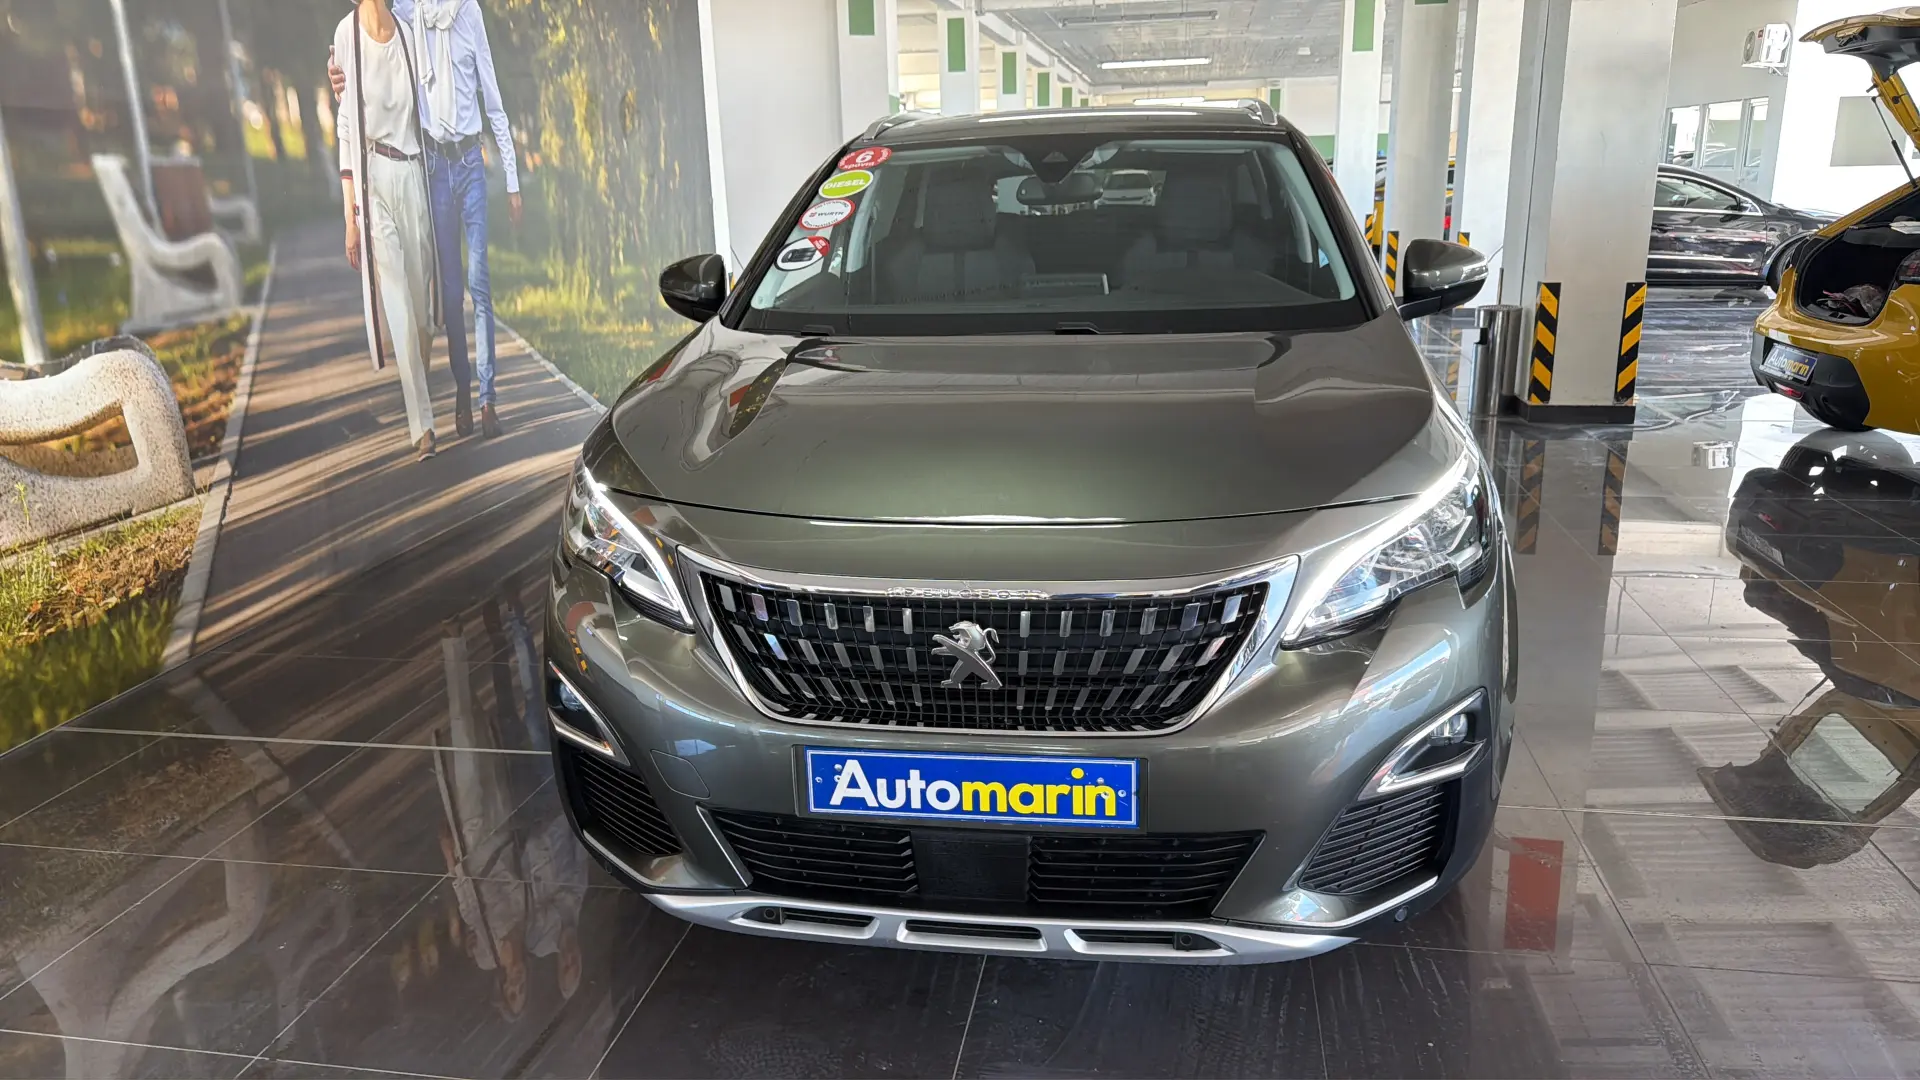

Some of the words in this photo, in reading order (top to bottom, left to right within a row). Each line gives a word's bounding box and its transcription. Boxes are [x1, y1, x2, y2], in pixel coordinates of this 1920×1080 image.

[855, 150, 875, 163] 6
[823, 178, 866, 190] DIESEL
[1767, 348, 1810, 377] Automarin
[829, 759, 1117, 817] Automarin
